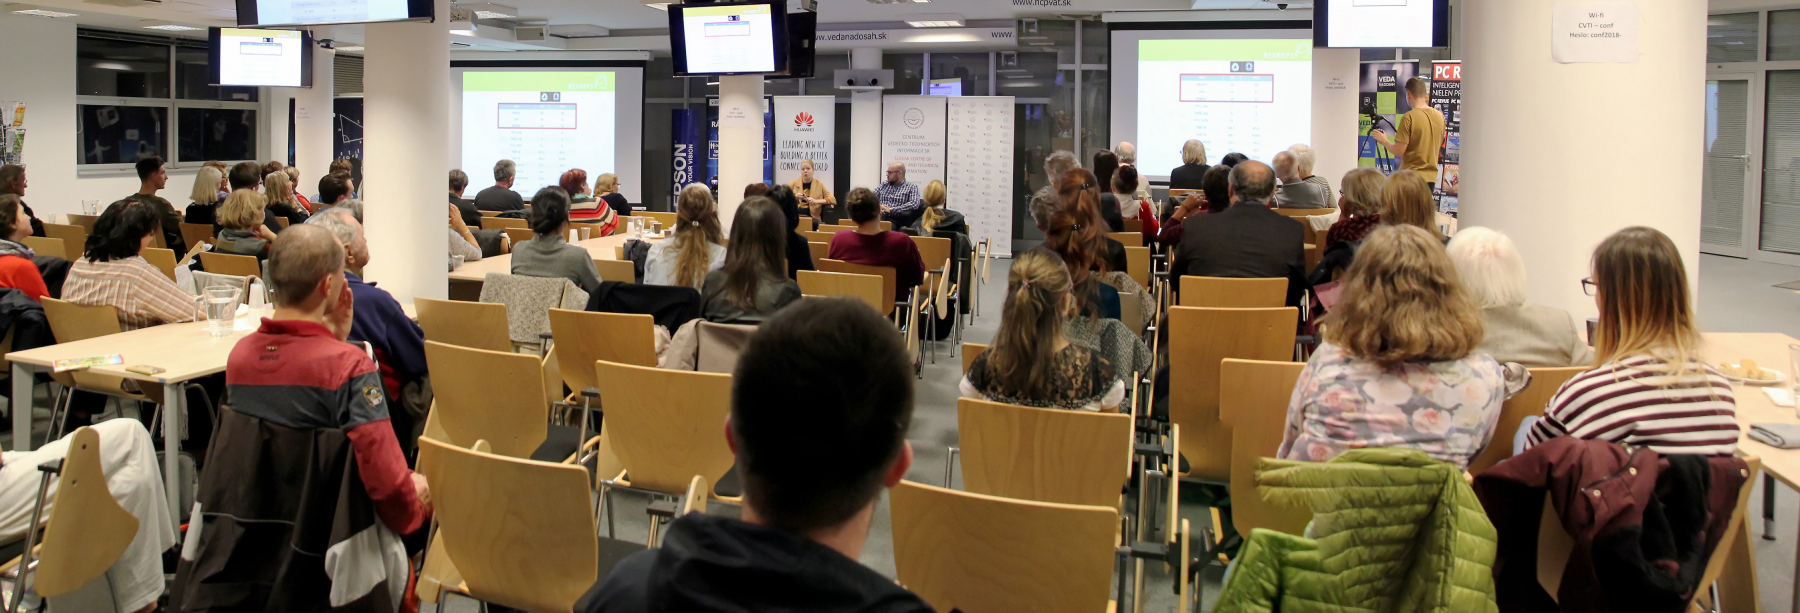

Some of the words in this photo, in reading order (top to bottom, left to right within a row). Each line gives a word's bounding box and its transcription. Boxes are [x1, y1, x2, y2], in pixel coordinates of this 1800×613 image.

[816, 32, 886, 40] w.vedanadosah.sk
[1435, 66, 1450, 79] PC
[783, 140, 803, 148] LEADING
[781, 151, 803, 160] BUILDING
[810, 152, 828, 160] BETTER
[815, 162, 828, 171] ORLD
